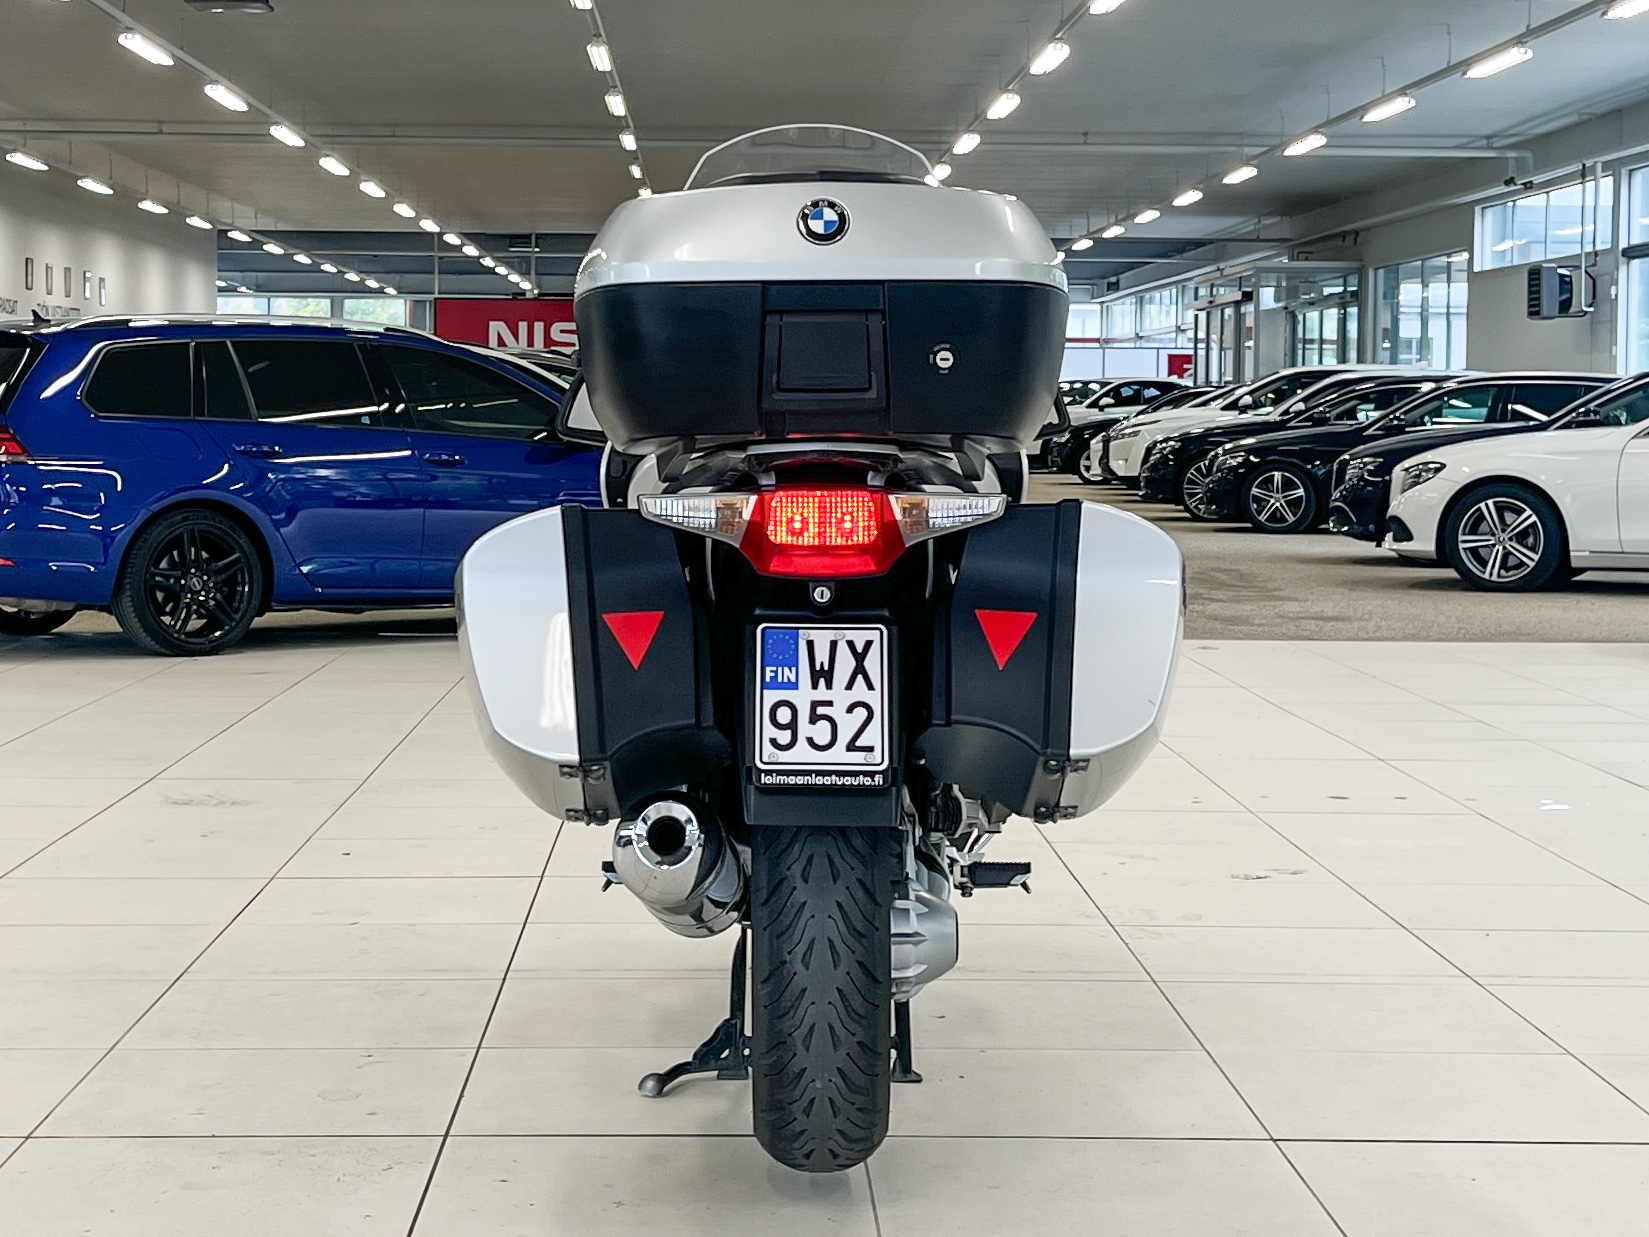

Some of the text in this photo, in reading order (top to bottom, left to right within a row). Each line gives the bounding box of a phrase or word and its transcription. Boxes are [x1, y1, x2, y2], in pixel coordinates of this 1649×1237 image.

[765, 666, 797, 683] FIN
[805, 639, 876, 691] WX
[768, 699, 875, 753] 952
[760, 773, 884, 786] loimaanlaatuauto.fi
